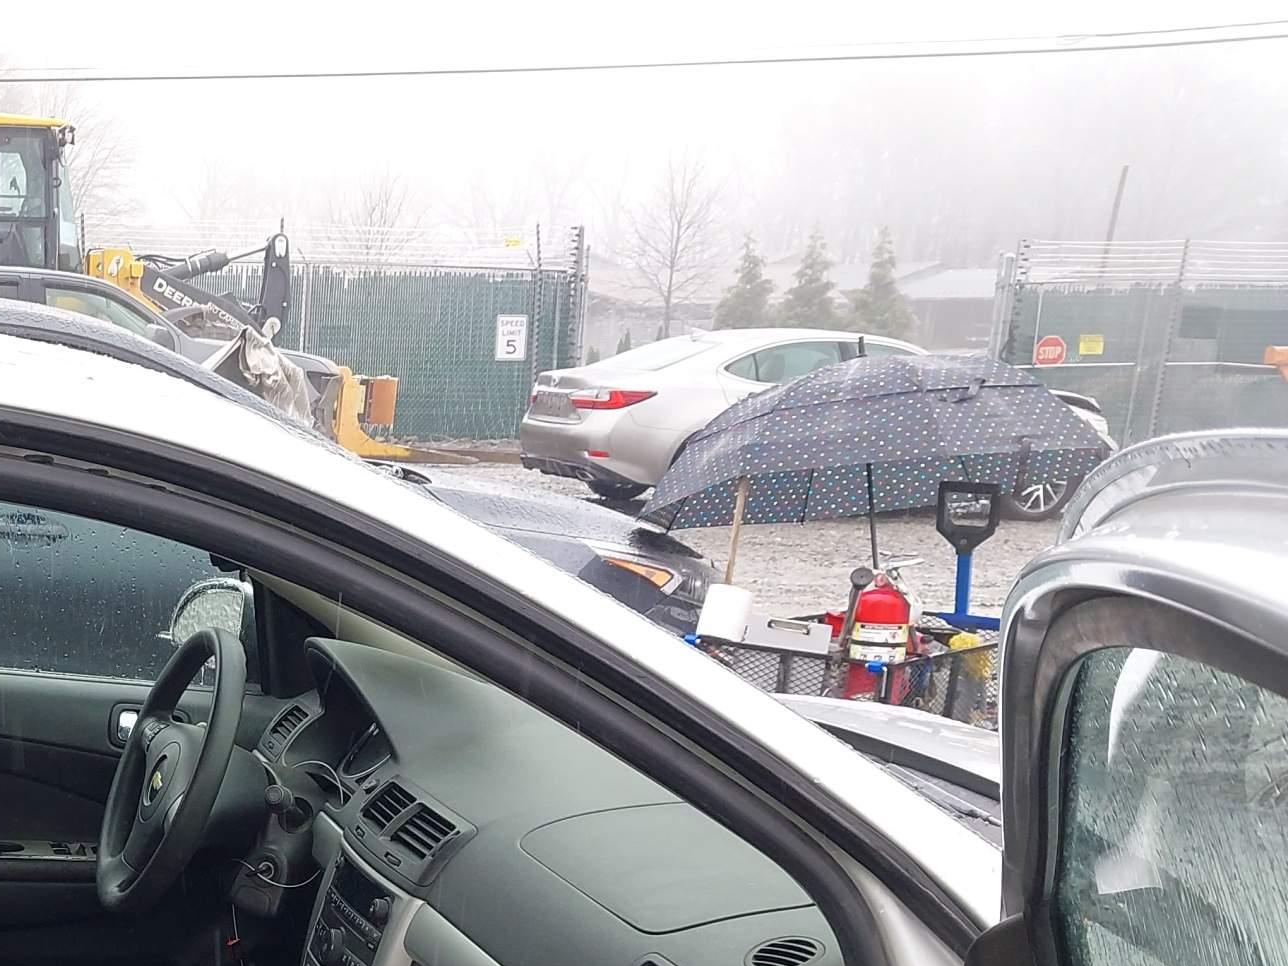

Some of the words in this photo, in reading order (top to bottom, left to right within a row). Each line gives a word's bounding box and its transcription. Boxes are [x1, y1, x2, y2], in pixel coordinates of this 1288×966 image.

[501, 320, 525, 328] SPEED
[506, 340, 517, 355] 5
[1038, 346, 1062, 360] STOP
